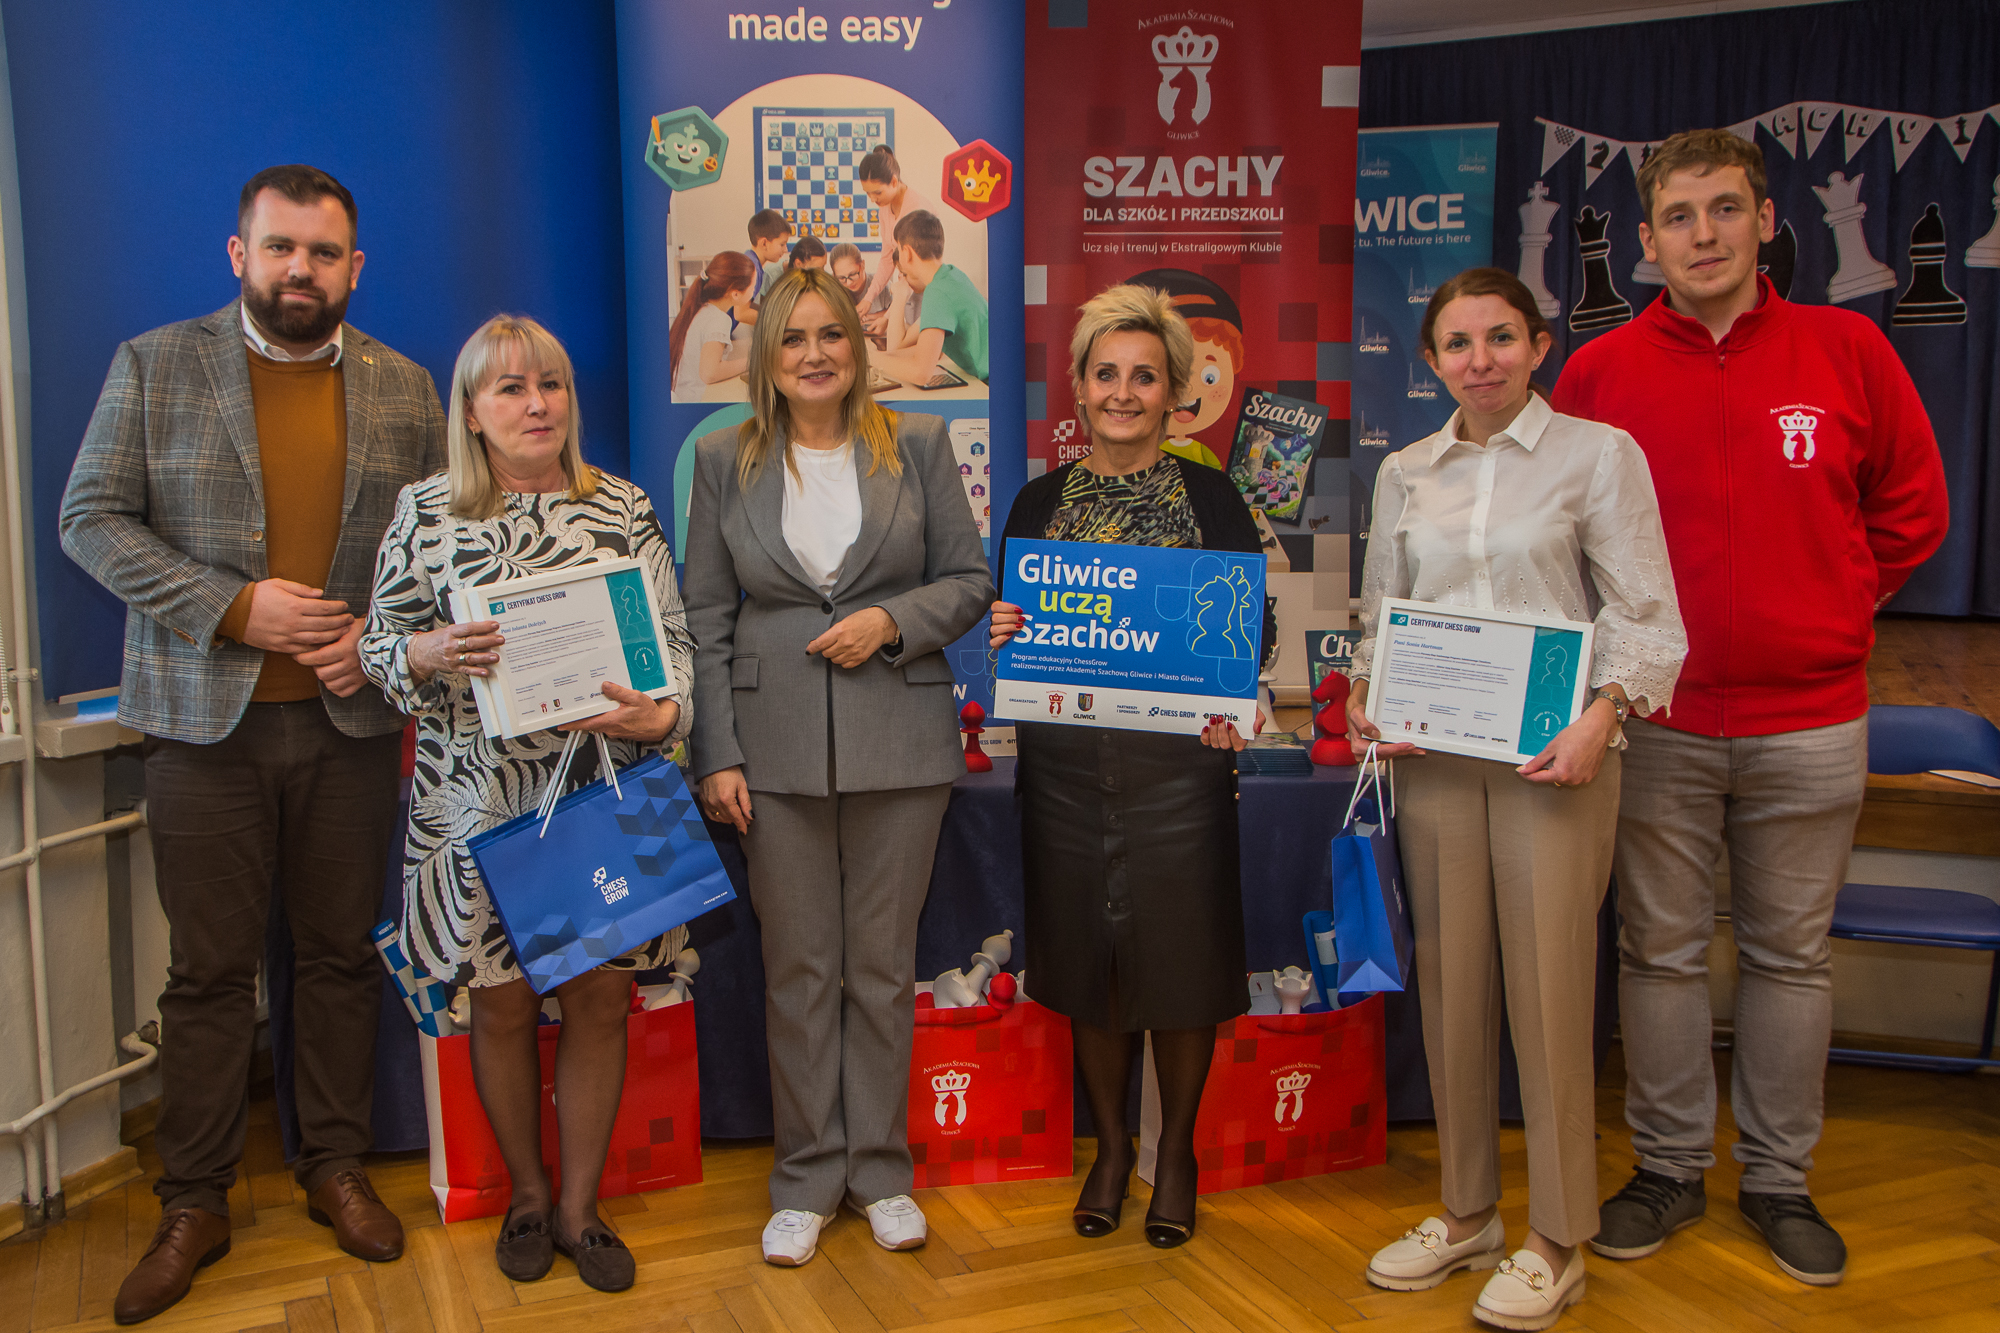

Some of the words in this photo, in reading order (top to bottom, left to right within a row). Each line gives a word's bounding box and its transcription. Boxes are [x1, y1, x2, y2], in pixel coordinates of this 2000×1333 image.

[728, 7, 828, 41] made
[840, 15, 923, 51] easy
[1083, 155, 1285, 198] SZACHY
[1083, 207, 1115, 221] DLA
[1118, 205, 1169, 221] SZKÓŁ
[1171, 208, 1176, 221] I
[1181, 207, 1284, 221] PRZEDSZKOLI
[1083, 242, 1102, 253] Ucz
[1104, 242, 1119, 255] się
[1127, 242, 1158, 255] trenuj
[1160, 244, 1169, 253] w
[1171, 242, 1248, 255] Ekstraligowym
[1250, 242, 1283, 253] Klubie
[1376, 236, 1396, 247] The
[1398, 234, 1433, 246] future
[1435, 234, 1444, 244] is
[1446, 233, 1472, 244] here
[1245, 394, 1322, 437] Szachy
[1018, 553, 1138, 590] Gliwice
[506, 597, 536, 610] CERTYFIKAT
[536, 594, 552, 604] CHESS
[552, 591, 567, 601] GROW
[1039, 589, 1113, 624] uczą
[1410, 618, 1445, 629] CERTYFIKAT
[1444, 622, 1463, 632] CHESS
[1463, 625, 1482, 634] GROW
[641, 653, 648, 665] 1
[1011, 653, 1038, 663] Program
[1038, 655, 1072, 665] edukacyjny
[1073, 657, 1108, 667] ChessGrow
[1010, 662, 1047, 672] realizowany
[1048, 665, 1066, 673] przez
[1066, 667, 1096, 676] Akademię
[1097, 668, 1129, 678] Szachową
[1129, 671, 1153, 679] Gliwice
[1157, 673, 1180, 681] Miasto
[1180, 674, 1205, 683] Gliwice
[1073, 713, 1096, 721] GLIWICE
[1160, 709, 1178, 718] CHESS
[1179, 710, 1197, 719] GROW
[1544, 718, 1550, 730] 1
[600, 876, 628, 895] CHESS
[604, 886, 629, 905] GROW
